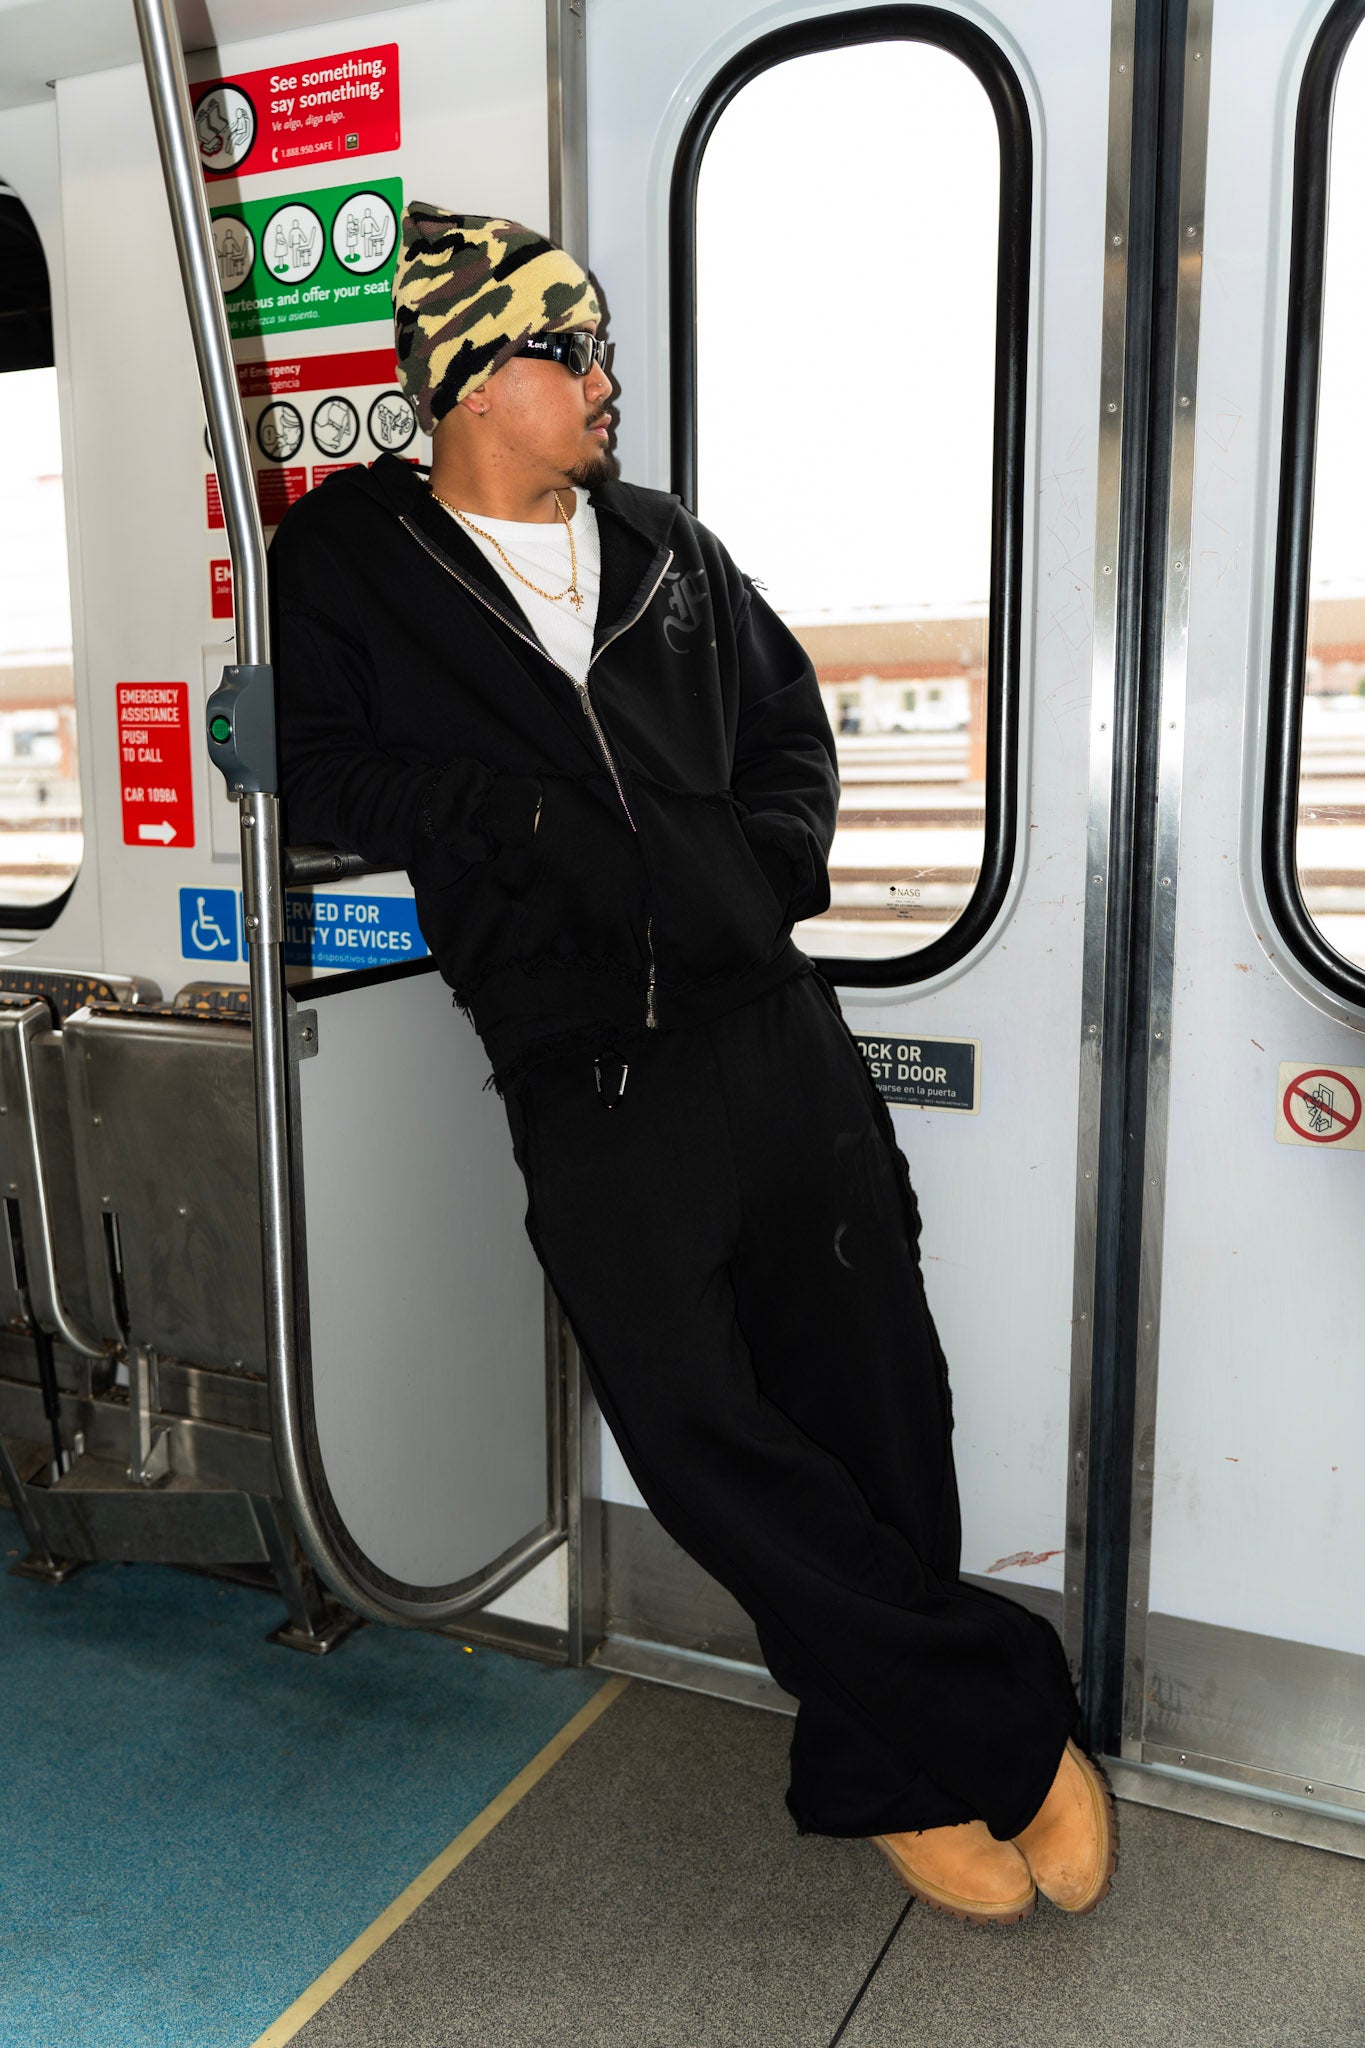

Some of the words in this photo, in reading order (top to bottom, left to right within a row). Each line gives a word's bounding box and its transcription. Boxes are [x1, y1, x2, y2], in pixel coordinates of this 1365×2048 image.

[270, 76, 297, 93] See
[301, 59, 387, 87] something,
[270, 98, 295, 116] say
[299, 81, 384, 109] something.
[272, 121, 282, 131] Ve
[283, 118, 303, 131] algo,
[305, 114, 323, 127] diga
[325, 110, 345, 124] algo.
[277, 290, 299, 307] and
[302, 286, 330, 304] offer
[333, 284, 360, 302] your
[364, 280, 391, 295] seat.
[277, 315, 287, 324] su
[288, 309, 320, 322] asiento.
[249, 364, 302, 379] Emergency
[120, 689, 179, 704] EMERGENCY
[121, 707, 180, 722] ASSISTANCE
[122, 730, 148, 745] PUSH
[123, 748, 135, 762] TO
[138, 748, 163, 763] CALL
[124, 788, 144, 802] CAR
[897, 888, 921, 898] NASG
[344, 904, 380, 924] FOR
[335, 929, 412, 950] DEVICES
[318, 953, 365, 965] dispositivos
[367, 955, 378, 964] de
[897, 1045, 922, 1063] OR
[867, 1061, 893, 1079] ST
[897, 1064, 947, 1084] DOOR
[904, 1086, 915, 1094] en
[917, 1085, 925, 1095] la
[927, 1087, 957, 1098] puerta
